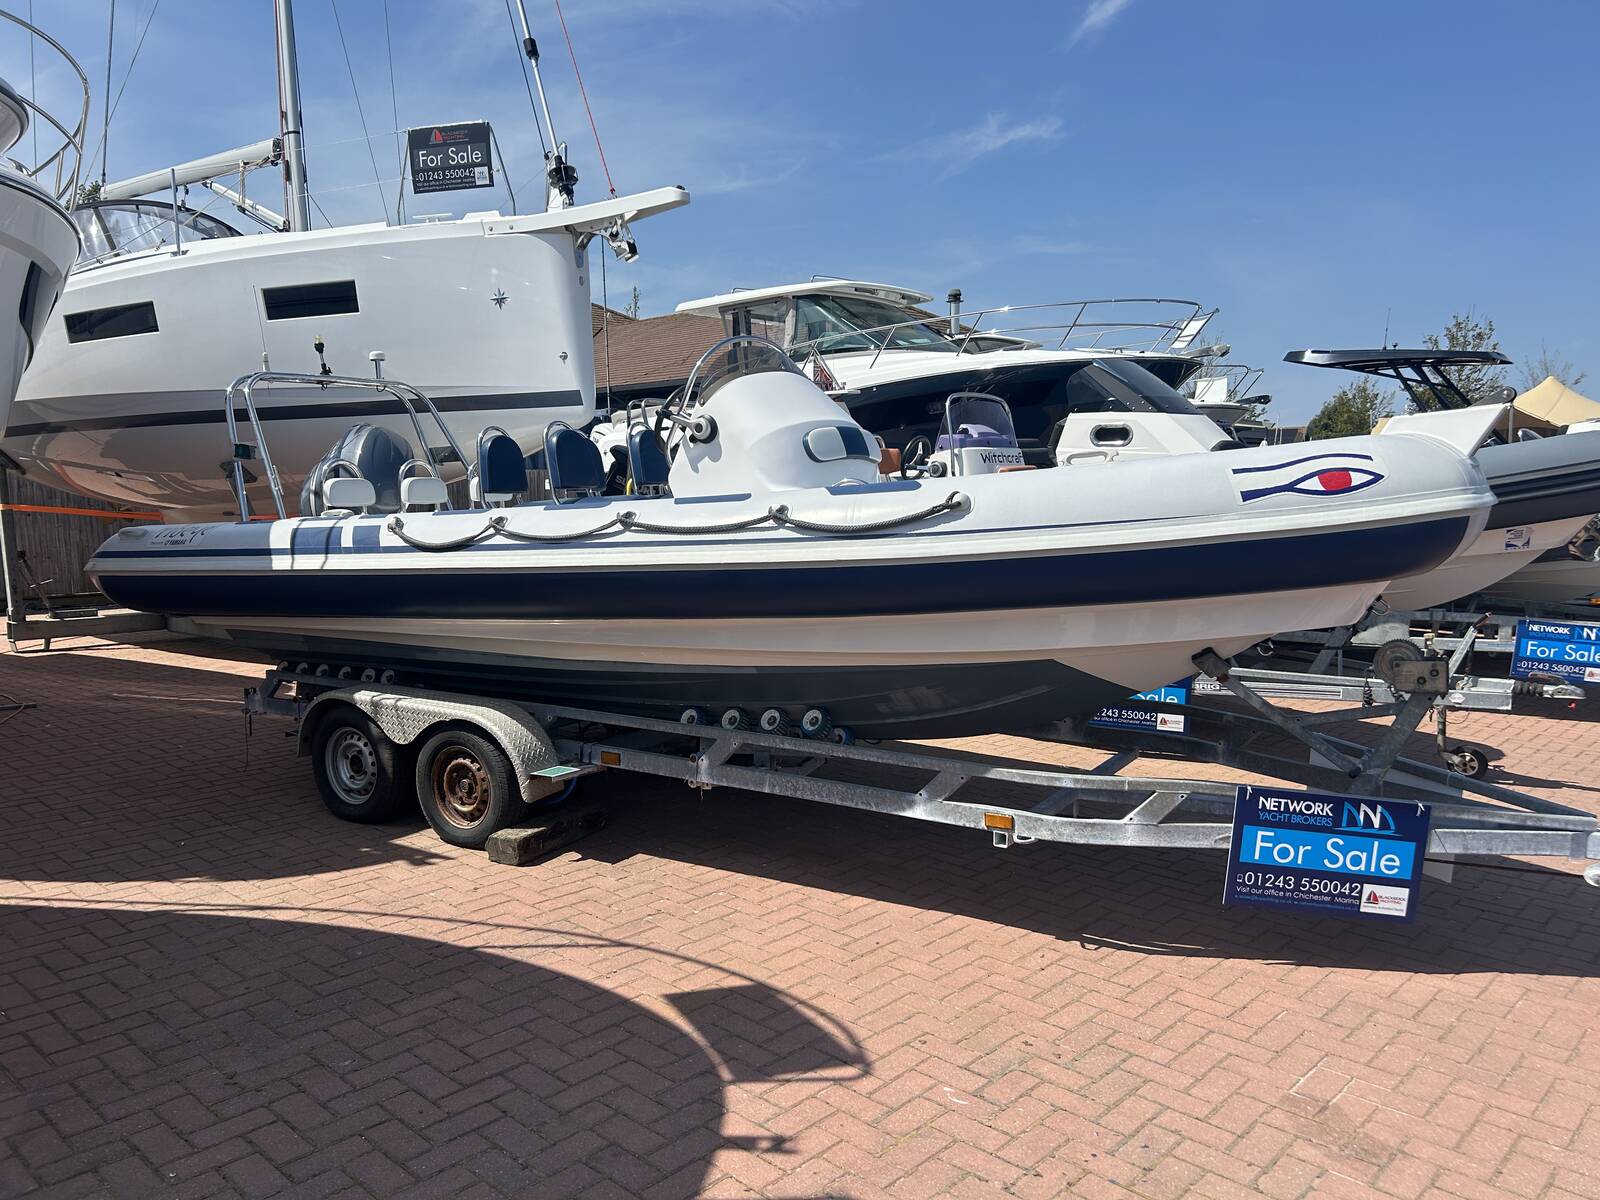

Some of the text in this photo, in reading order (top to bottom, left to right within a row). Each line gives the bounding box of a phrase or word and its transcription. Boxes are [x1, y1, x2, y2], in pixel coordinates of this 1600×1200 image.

[419, 145, 482, 167] For Sale
[418, 168, 475, 182] 01243 550042
[980, 451, 1023, 464] Witchcraf
[1528, 624, 1570, 634] NETWORK
[1526, 641, 1559, 658] For
[1521, 661, 1549, 670] 01243
[1551, 664, 1585, 673] 550042
[1097, 708, 1157, 721] 243 550042
[1258, 796, 1334, 816] NETWORK
[1258, 811, 1333, 827] YACHT BROKERS
[1254, 830, 1400, 875] For Sale
[1244, 871, 1361, 896] 01243 550042
[1264, 889, 1284, 897] office
[1334, 896, 1360, 905] Marina
